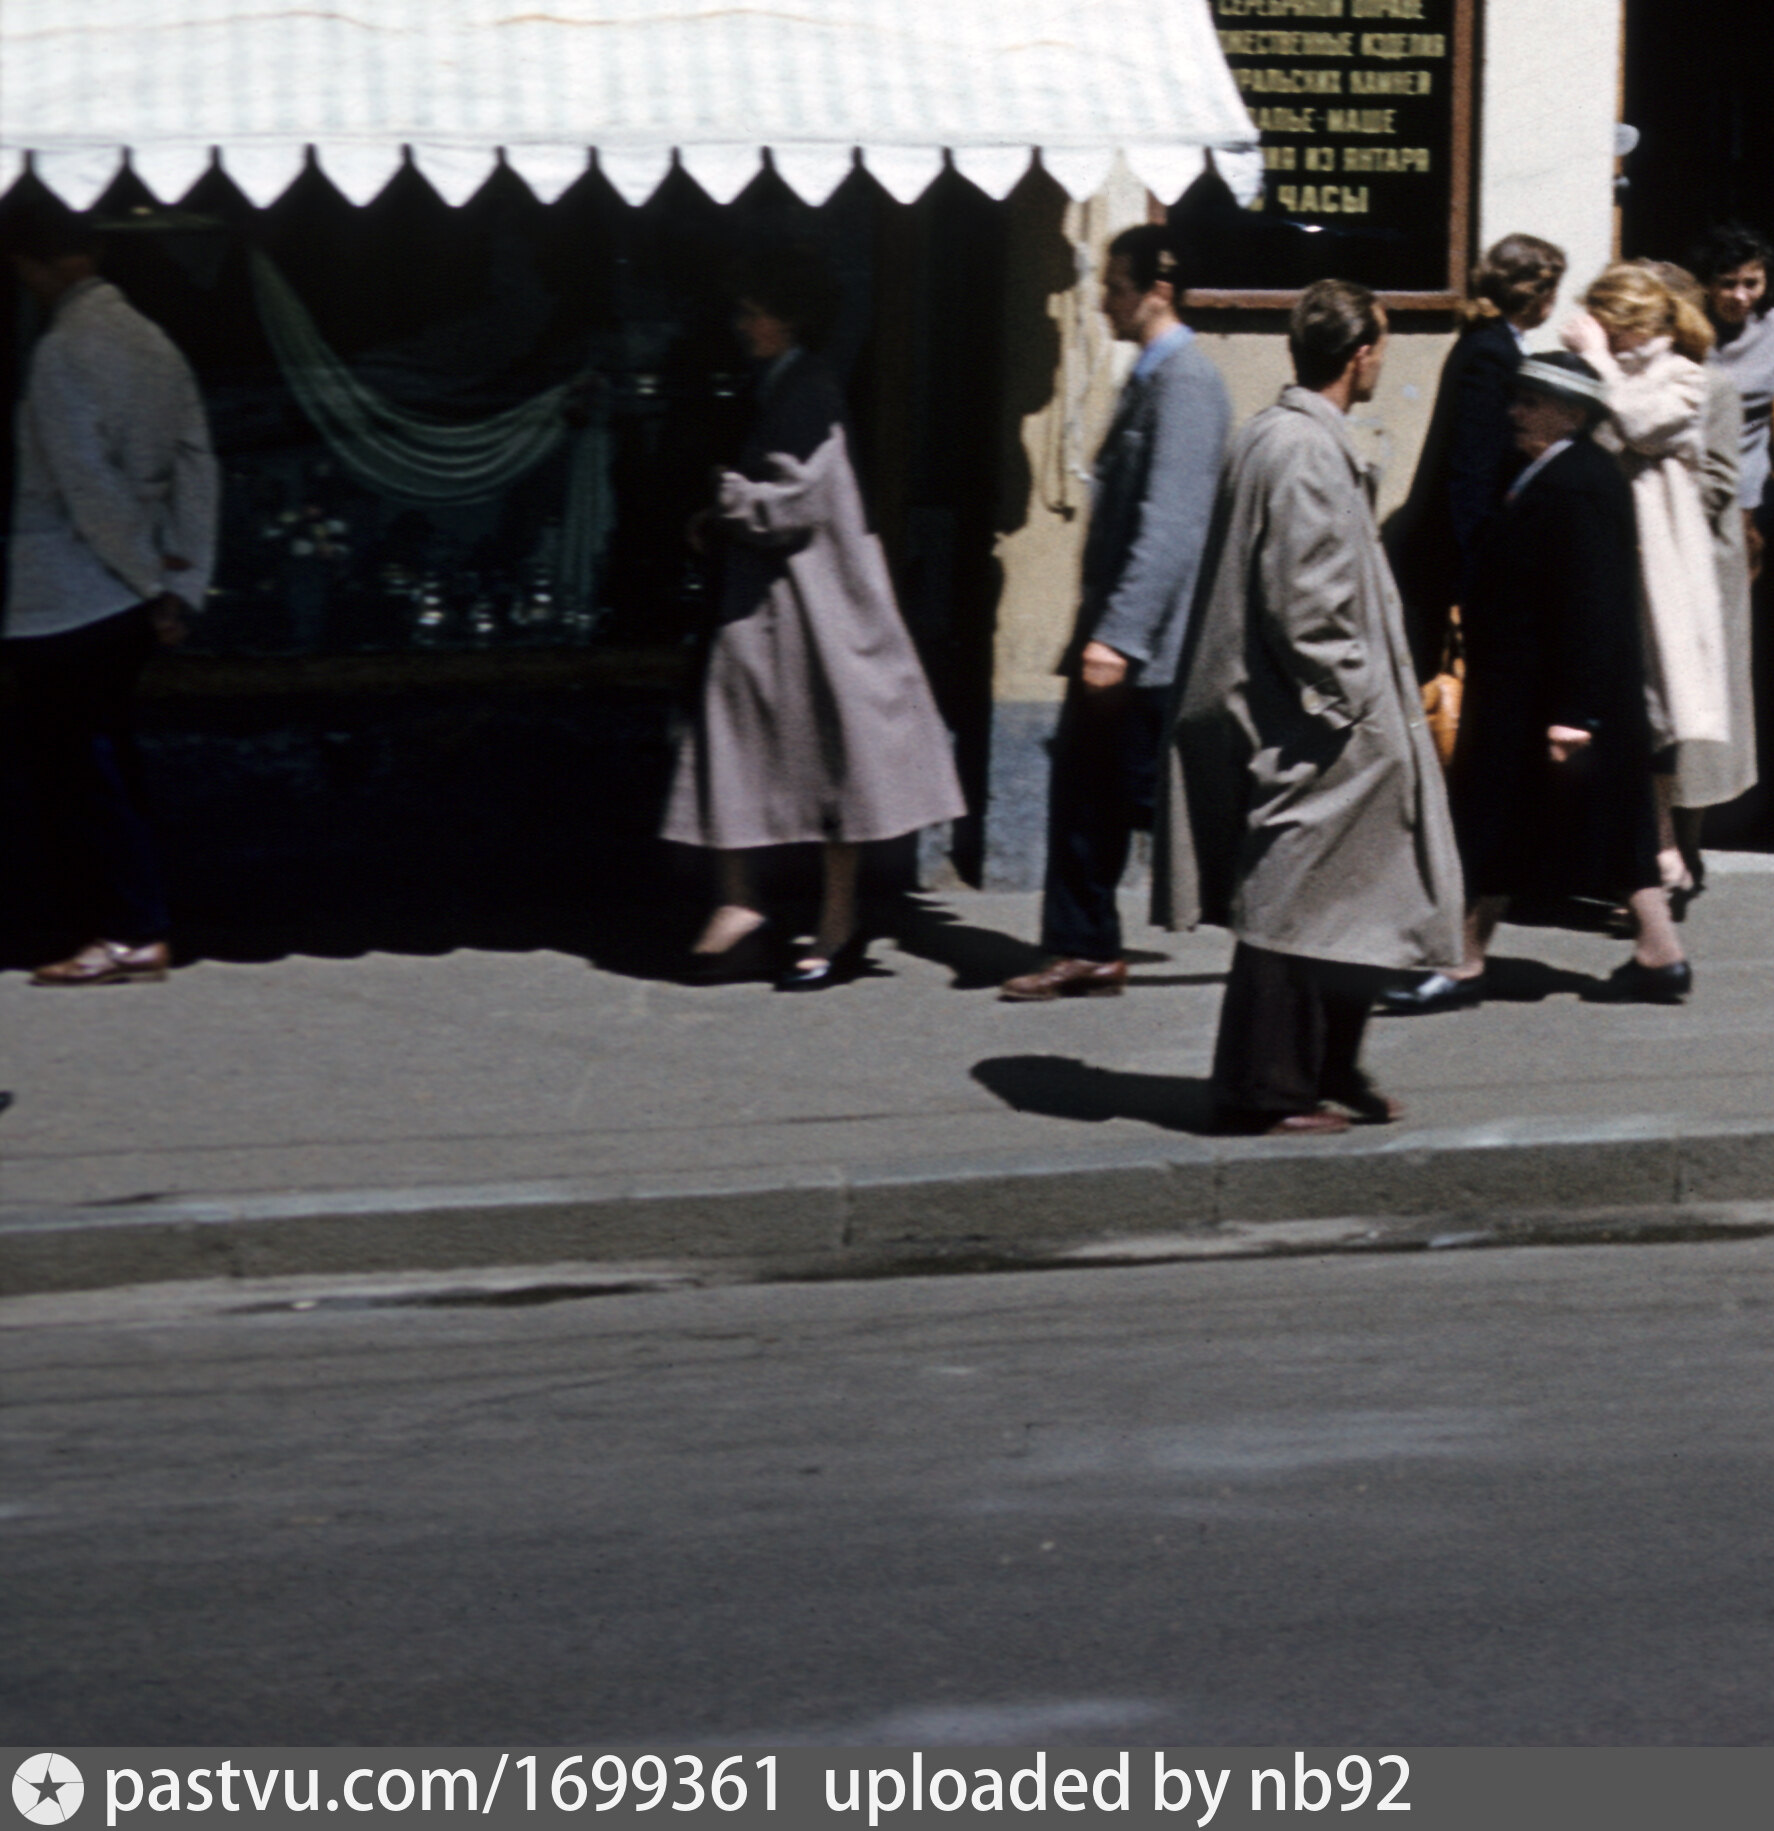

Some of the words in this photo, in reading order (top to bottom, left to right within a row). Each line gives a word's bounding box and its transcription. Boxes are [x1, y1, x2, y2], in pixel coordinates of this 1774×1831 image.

[1231, 69, 1341, 93] РАЛЬСКИХ
[1306, 147, 1334, 171] ИЗ
[1343, 147, 1429, 172] ЯНТАРЯ
[1277, 185, 1368, 213] ЧАСЫ
